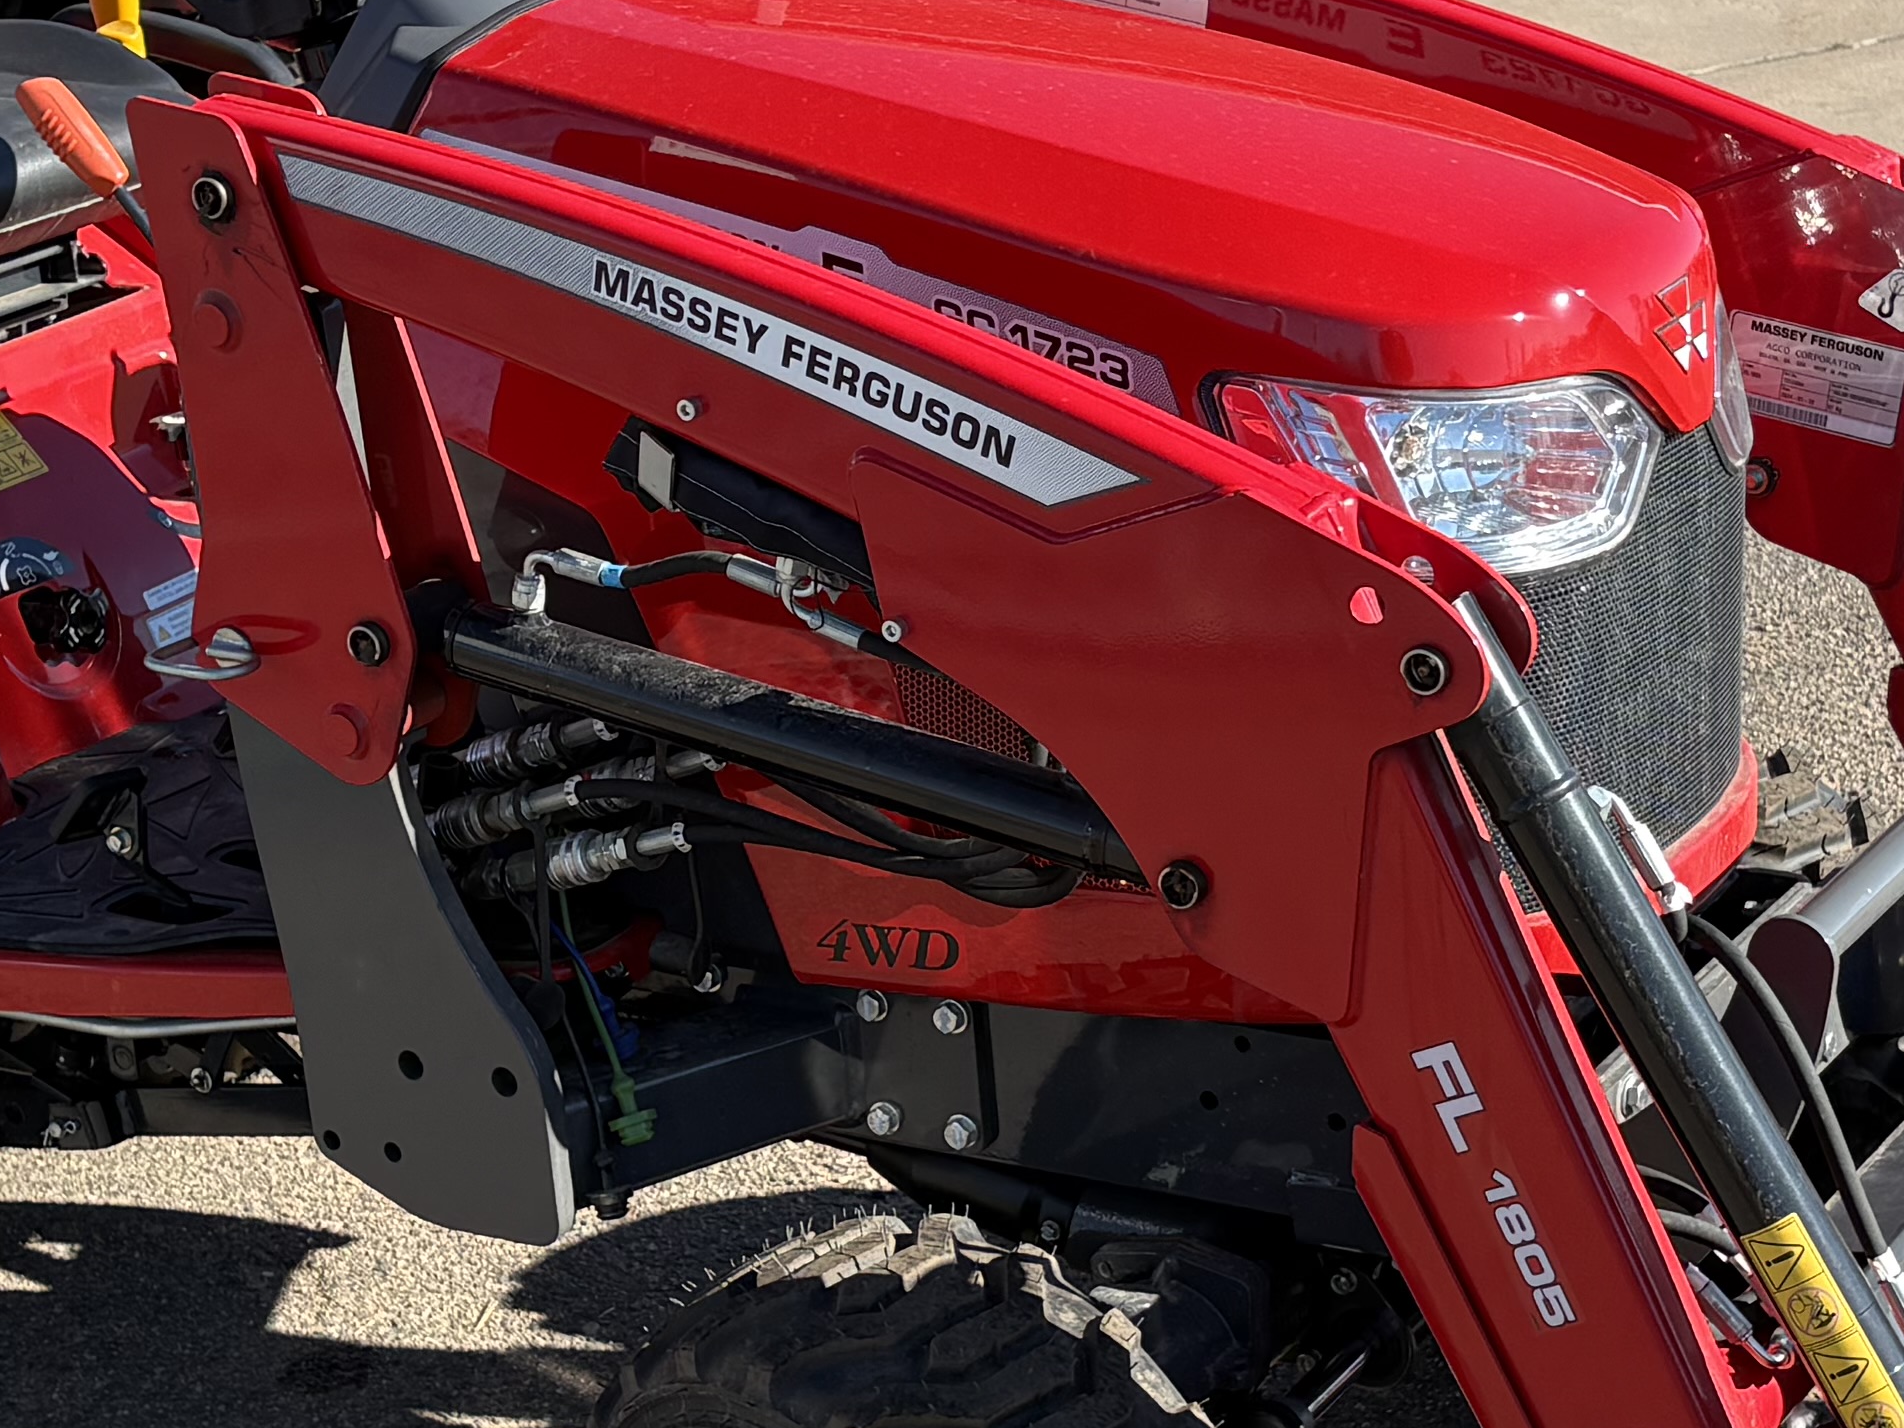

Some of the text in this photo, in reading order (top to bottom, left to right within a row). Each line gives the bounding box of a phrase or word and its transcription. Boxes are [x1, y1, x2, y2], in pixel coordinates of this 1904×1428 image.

[593, 260, 1017, 468] MASSEY FERGUSON
[1008, 323, 1131, 391] 1723
[1750, 319, 1885, 362] MASSEY FERGUSON
[1794, 349, 1863, 373] CORPORATION
[816, 918, 961, 971] 4WD
[1410, 1040, 1578, 1328] FL 1805
